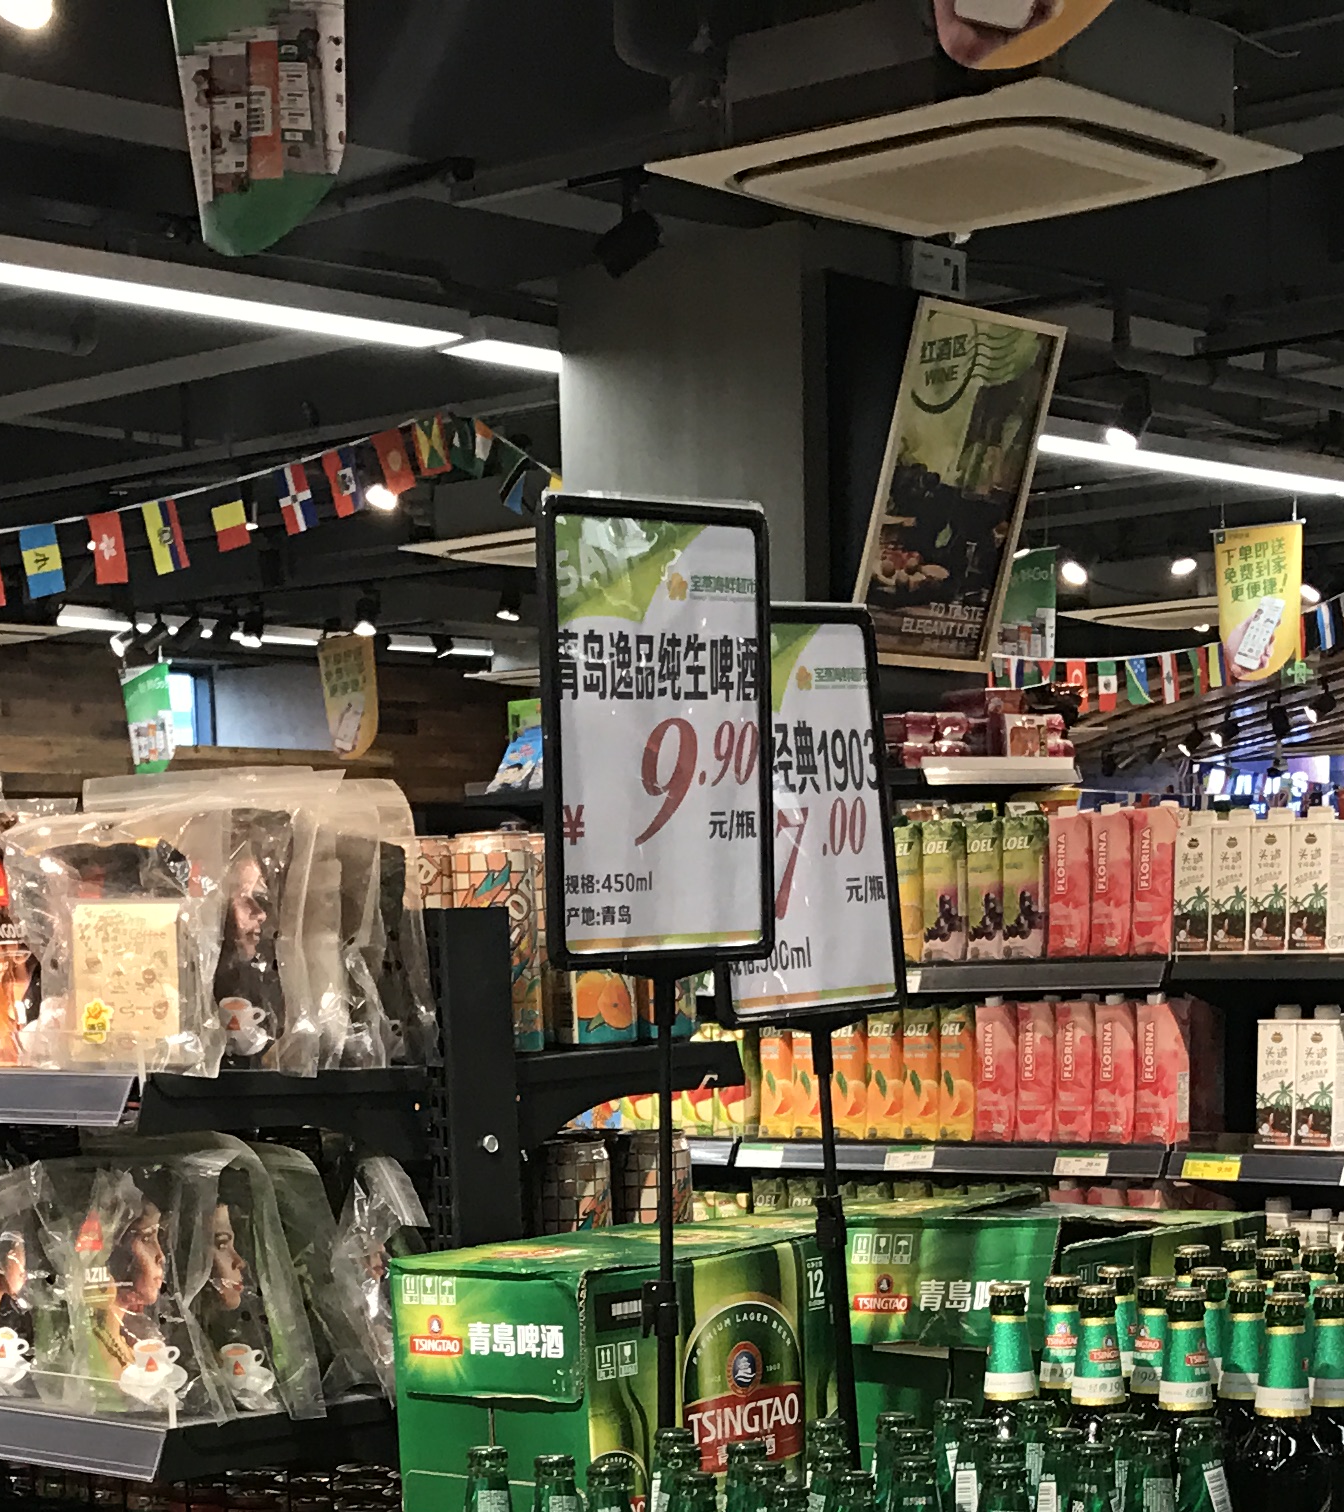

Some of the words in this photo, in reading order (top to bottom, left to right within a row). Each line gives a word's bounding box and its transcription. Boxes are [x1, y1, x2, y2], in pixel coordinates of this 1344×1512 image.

[919, 334, 968, 364] 红酒区
[1221, 537, 1286, 566] 下单即送
[1223, 556, 1288, 586] 免费到家
[901, 617, 955, 637] ELEGANT
[956, 622, 981, 640] LIFE
[948, 604, 985, 622] TASTE
[558, 628, 759, 702] 青岛逸品纯生啤酒
[709, 808, 758, 841] 元/瓶
[1056, 834, 1067, 893] FLORINA
[1096, 831, 1108, 892] FLORINA
[1138, 829, 1151, 891] FLORINA
[846, 875, 885, 904] 元/瓶
[983, 1022, 996, 1081] FLORINA
[1023, 1021, 1035, 1080] FLORINA
[1062, 1021, 1075, 1080] FLORINA
[1101, 1021, 1114, 1081] FLORINA
[1142, 1021, 1156, 1081] FLORINA
[807, 1268, 825, 1300] 12
[857, 1297, 909, 1312] TSINGTAO
[412, 1337, 462, 1356] TSINGTAO
[692, 1317, 732, 1366] PREMIUM
[735, 1311, 769, 1325] LAGER
[771, 1319, 792, 1348] BEER
[688, 1392, 800, 1445] TSINGTAO
